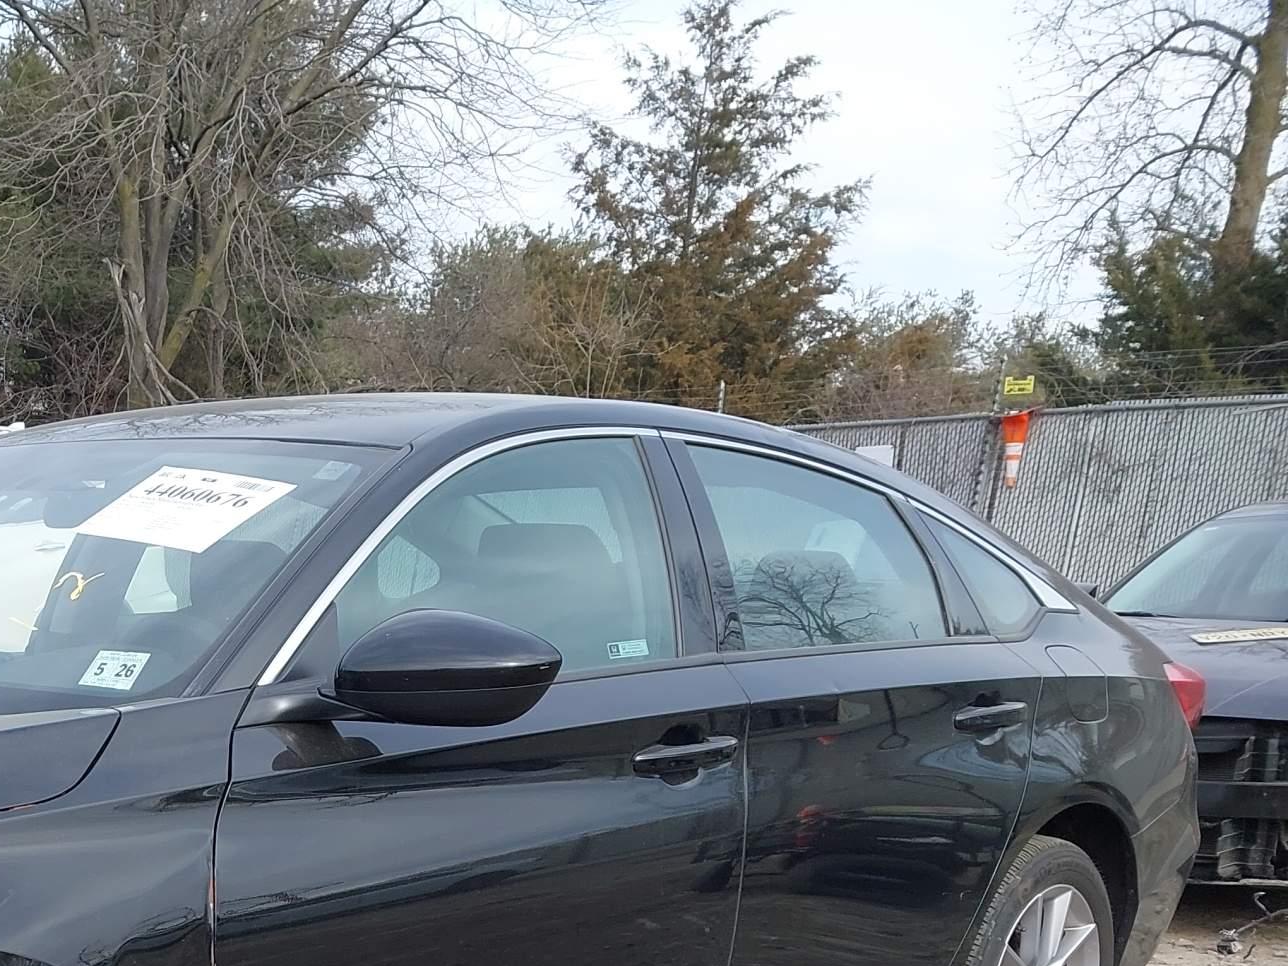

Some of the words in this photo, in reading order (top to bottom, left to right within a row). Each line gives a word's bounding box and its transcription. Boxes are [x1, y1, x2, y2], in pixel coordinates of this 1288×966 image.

[143, 482, 257, 509] 44060676
[93, 662, 108, 677] 5
[114, 663, 137, 678] 26
